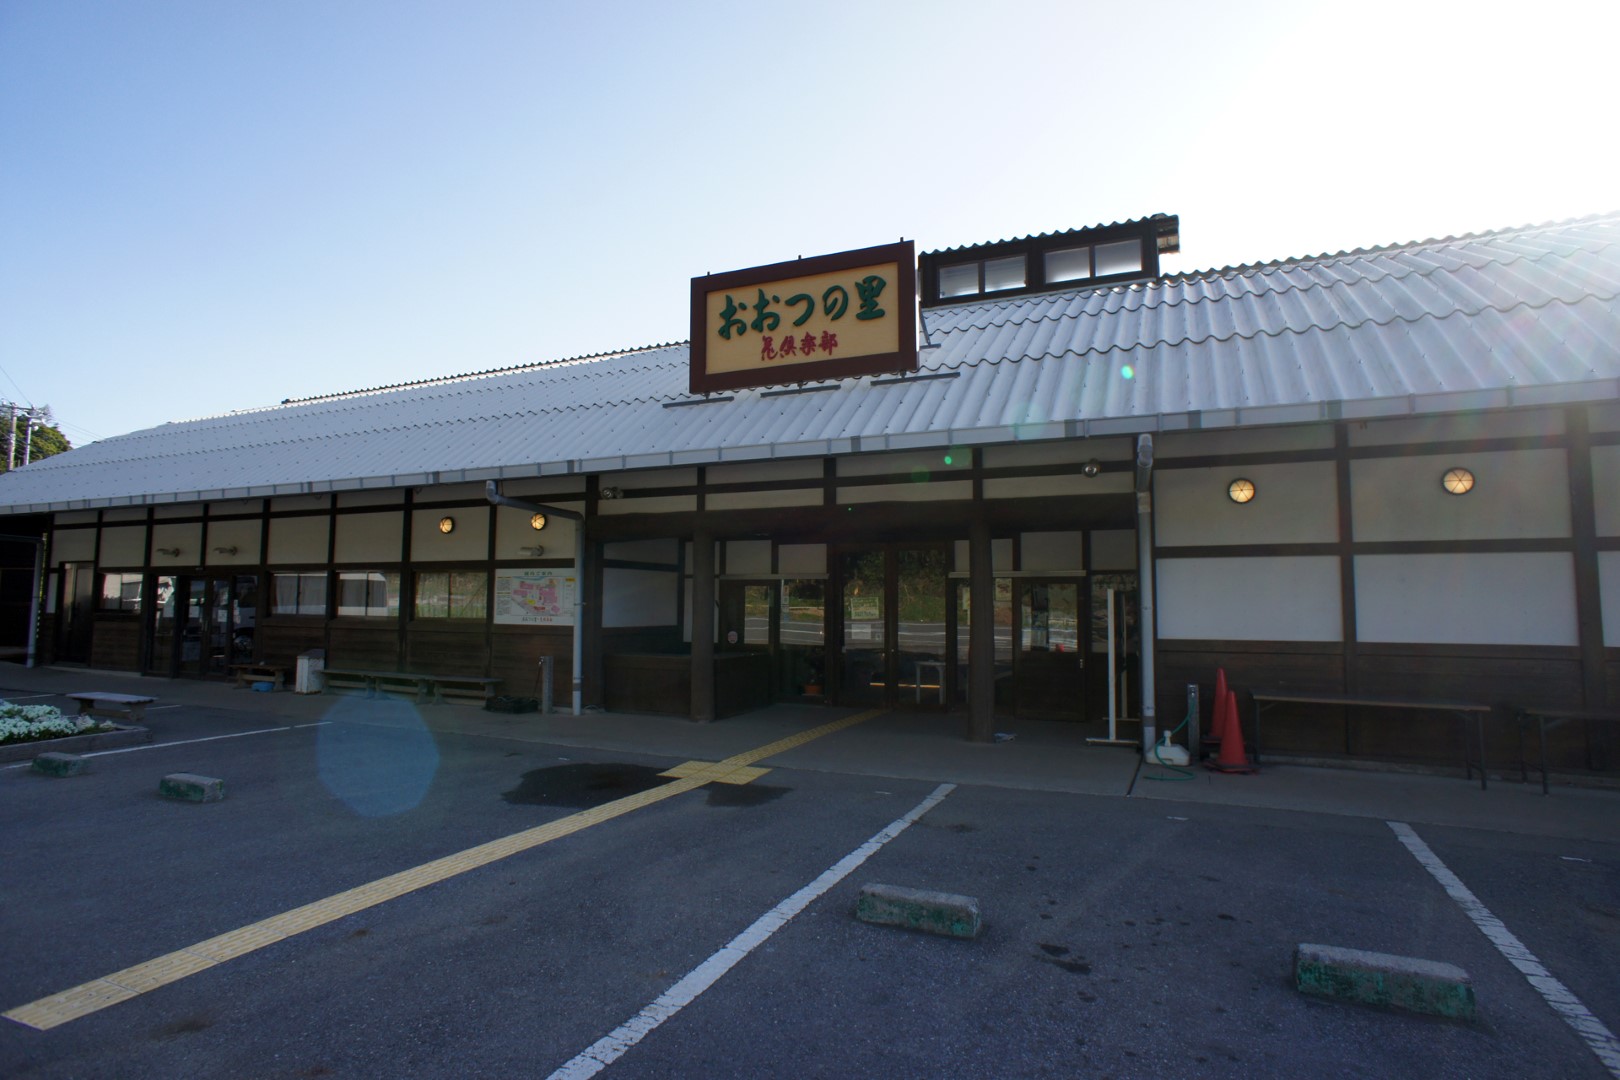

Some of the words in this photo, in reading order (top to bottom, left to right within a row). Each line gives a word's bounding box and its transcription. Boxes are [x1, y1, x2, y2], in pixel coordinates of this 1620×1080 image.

[718, 275, 886, 340] おおつの里
